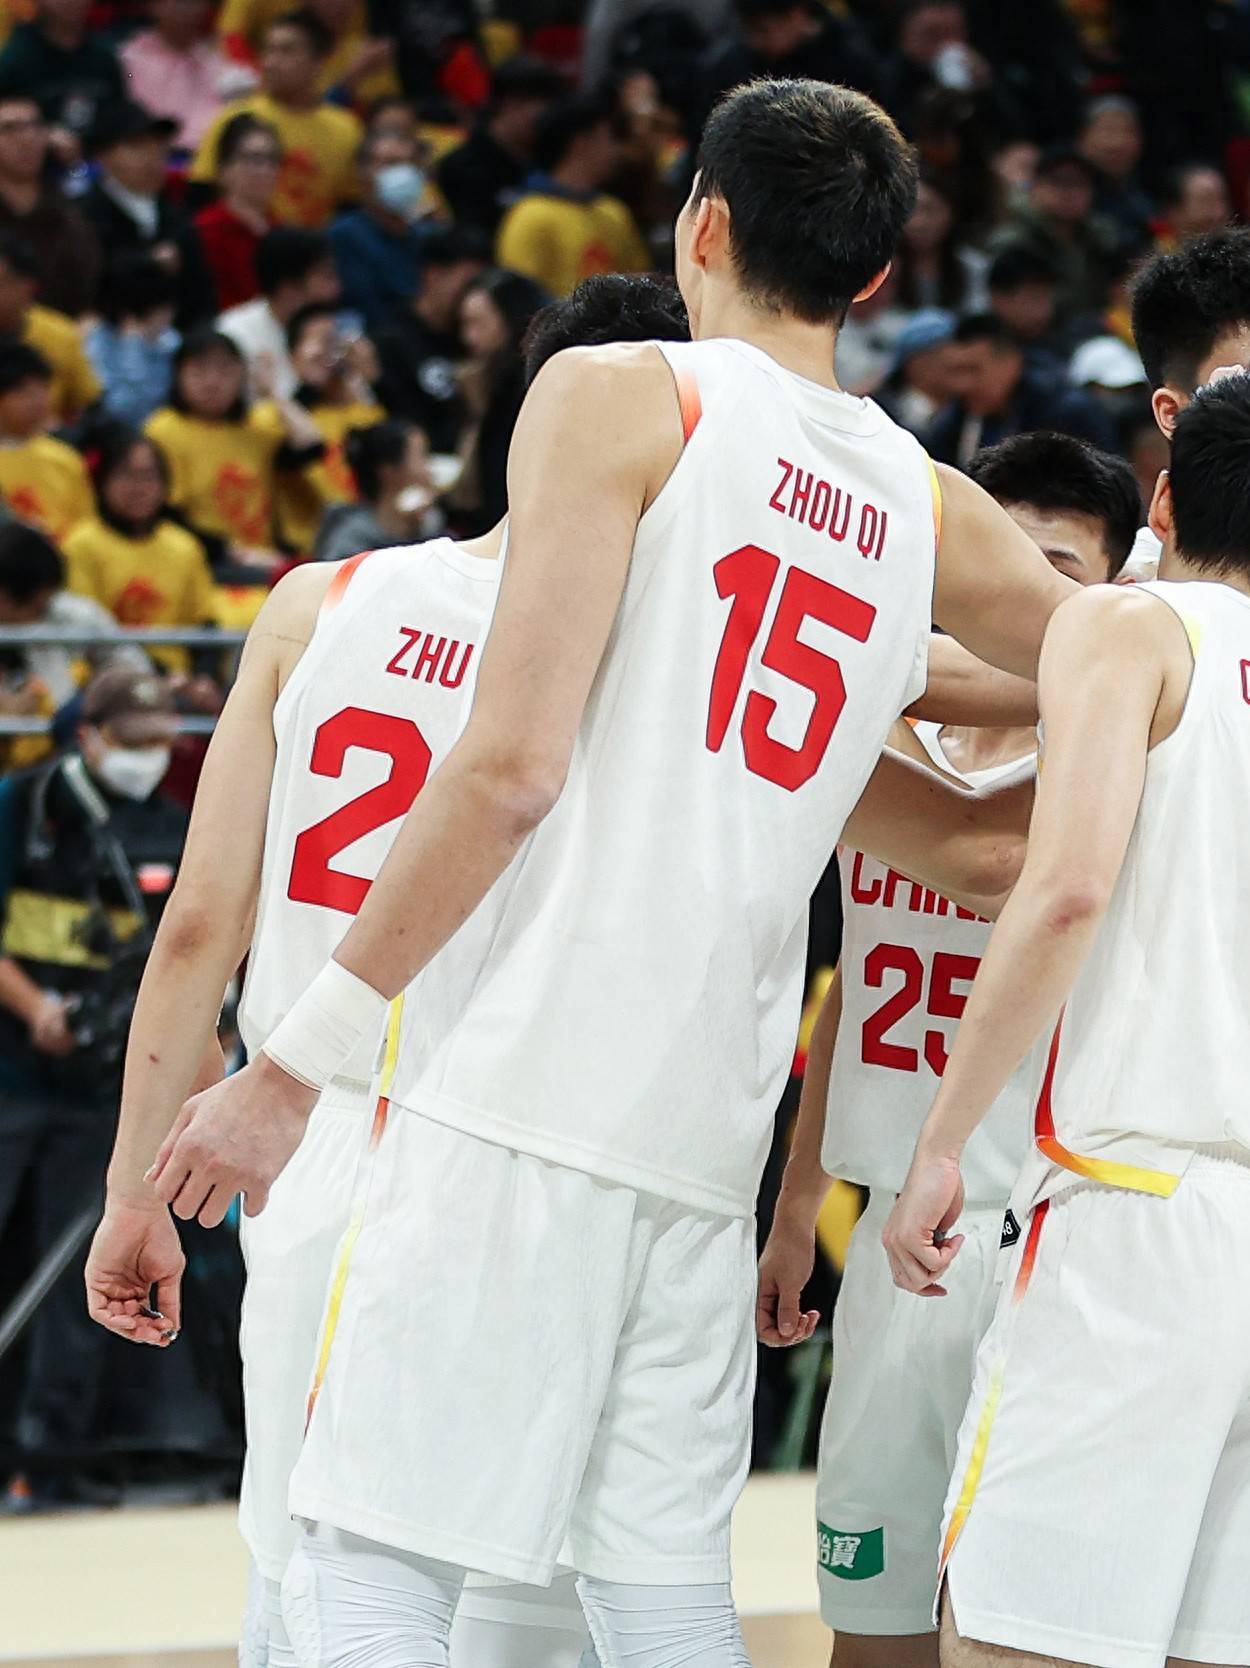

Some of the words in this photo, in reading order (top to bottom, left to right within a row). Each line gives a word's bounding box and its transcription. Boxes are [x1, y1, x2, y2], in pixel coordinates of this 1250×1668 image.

[769, 457, 852, 542] ZHOU
[857, 503, 887, 562] QI
[386, 627, 474, 688] ZHU
[705, 544, 877, 792] 15
[861, 943, 982, 1077] 25
